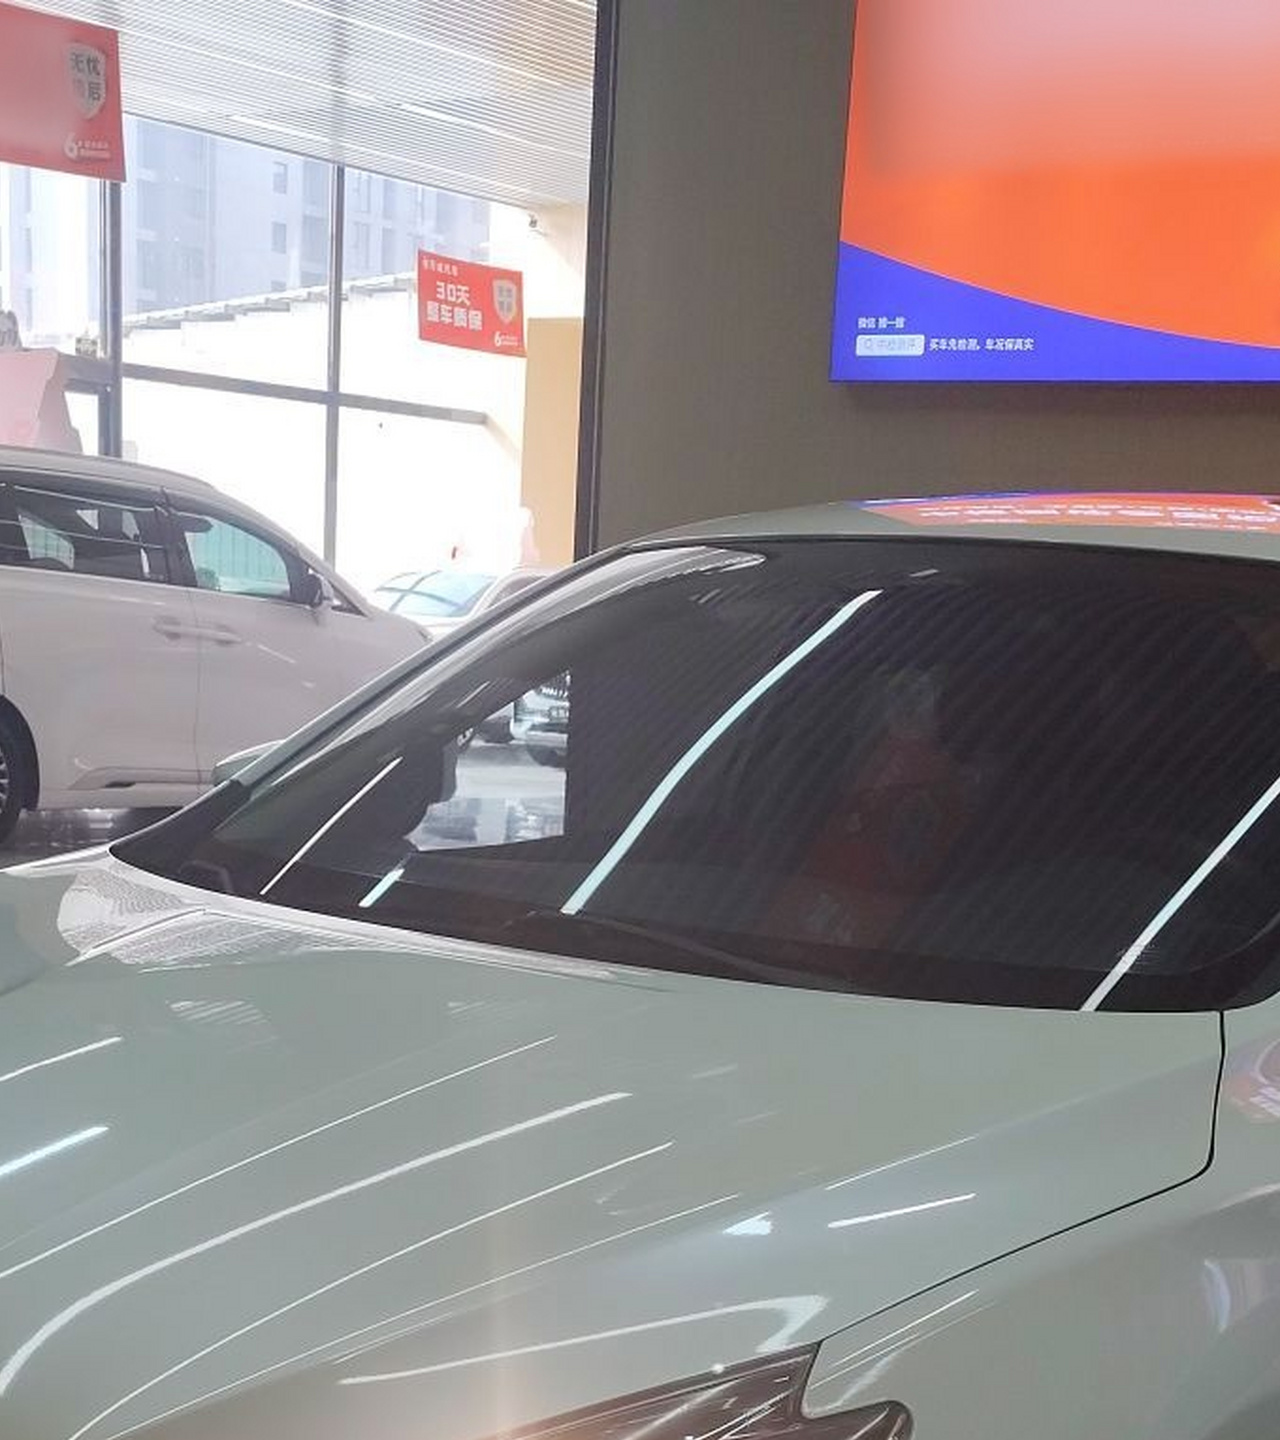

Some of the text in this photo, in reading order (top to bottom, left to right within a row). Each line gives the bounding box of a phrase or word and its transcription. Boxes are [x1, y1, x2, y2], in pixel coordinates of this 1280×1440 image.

[70, 51, 101, 76] 无忧
[436, 280, 471, 306] 30天
[426, 300, 483, 331] 整车质保
